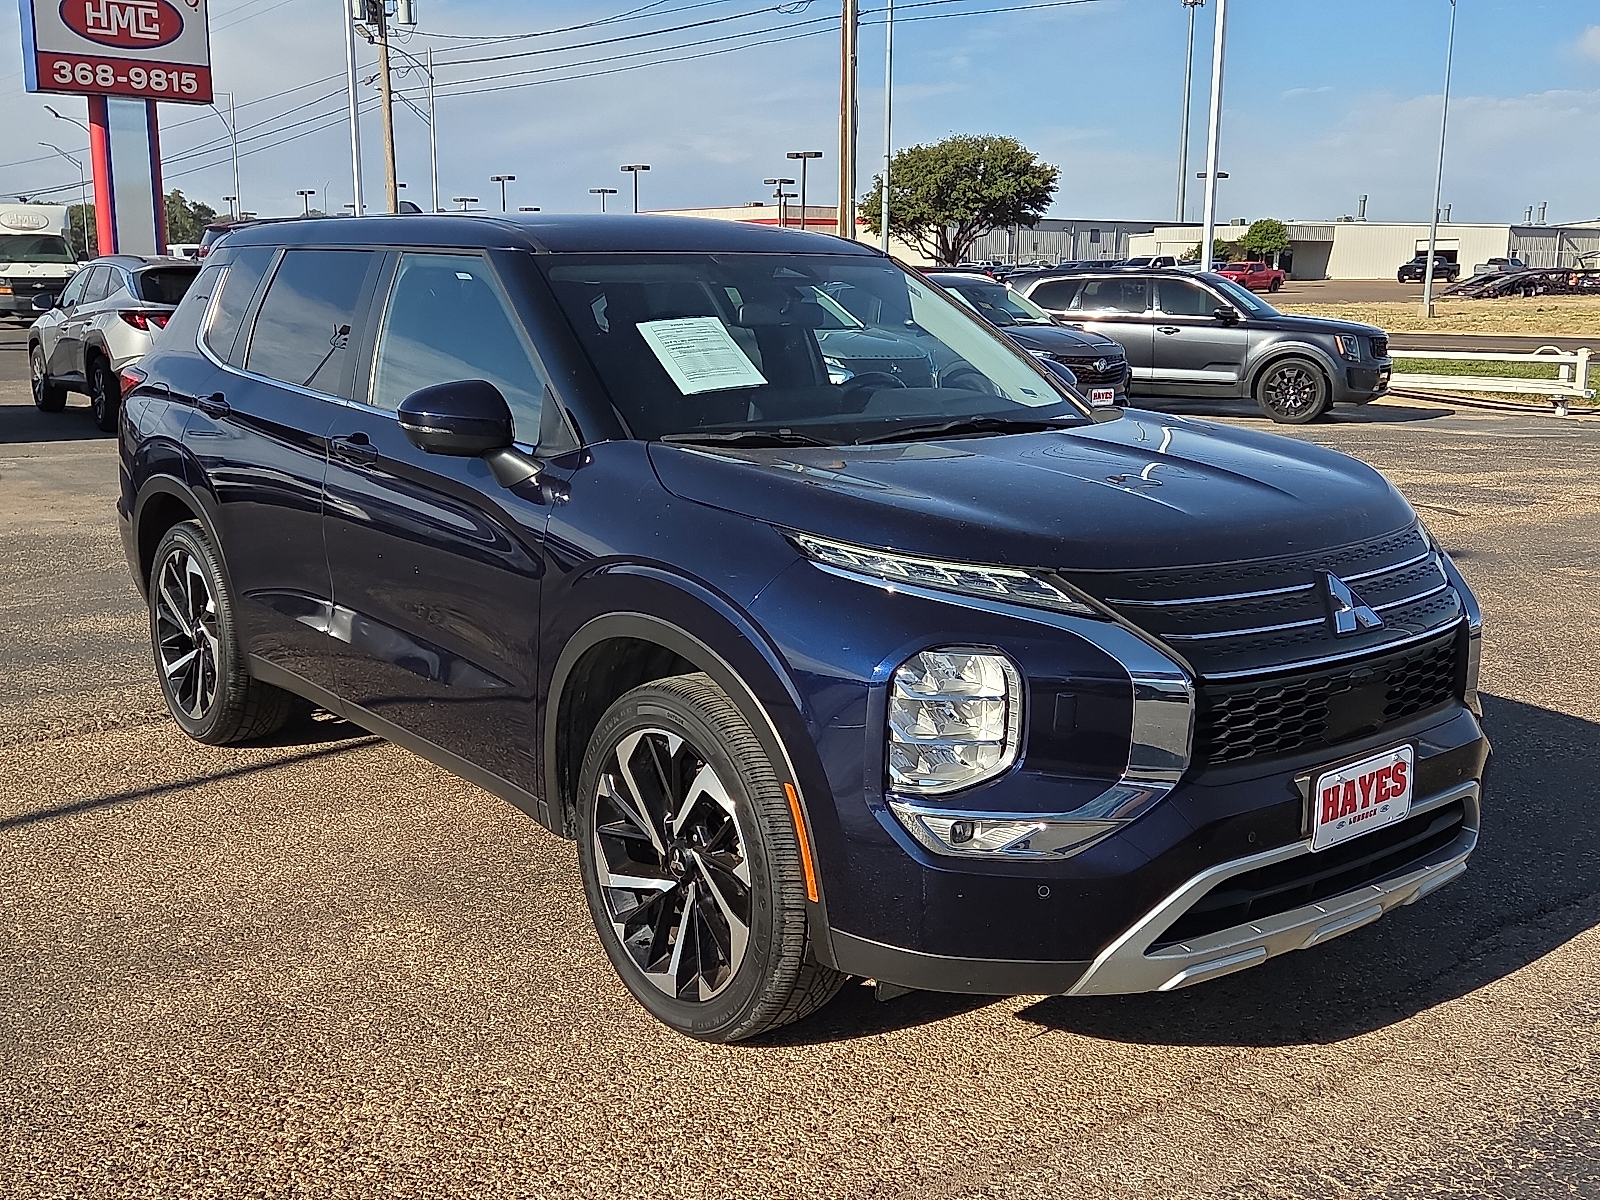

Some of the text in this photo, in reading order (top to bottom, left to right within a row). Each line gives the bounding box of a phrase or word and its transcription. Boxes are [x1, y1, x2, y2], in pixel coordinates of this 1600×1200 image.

[85, 0, 160, 40] HMC
[53, 61, 198, 93] 368-9815
[1093, 391, 1112, 400] HAYES
[1321, 761, 1407, 825] HAYES
